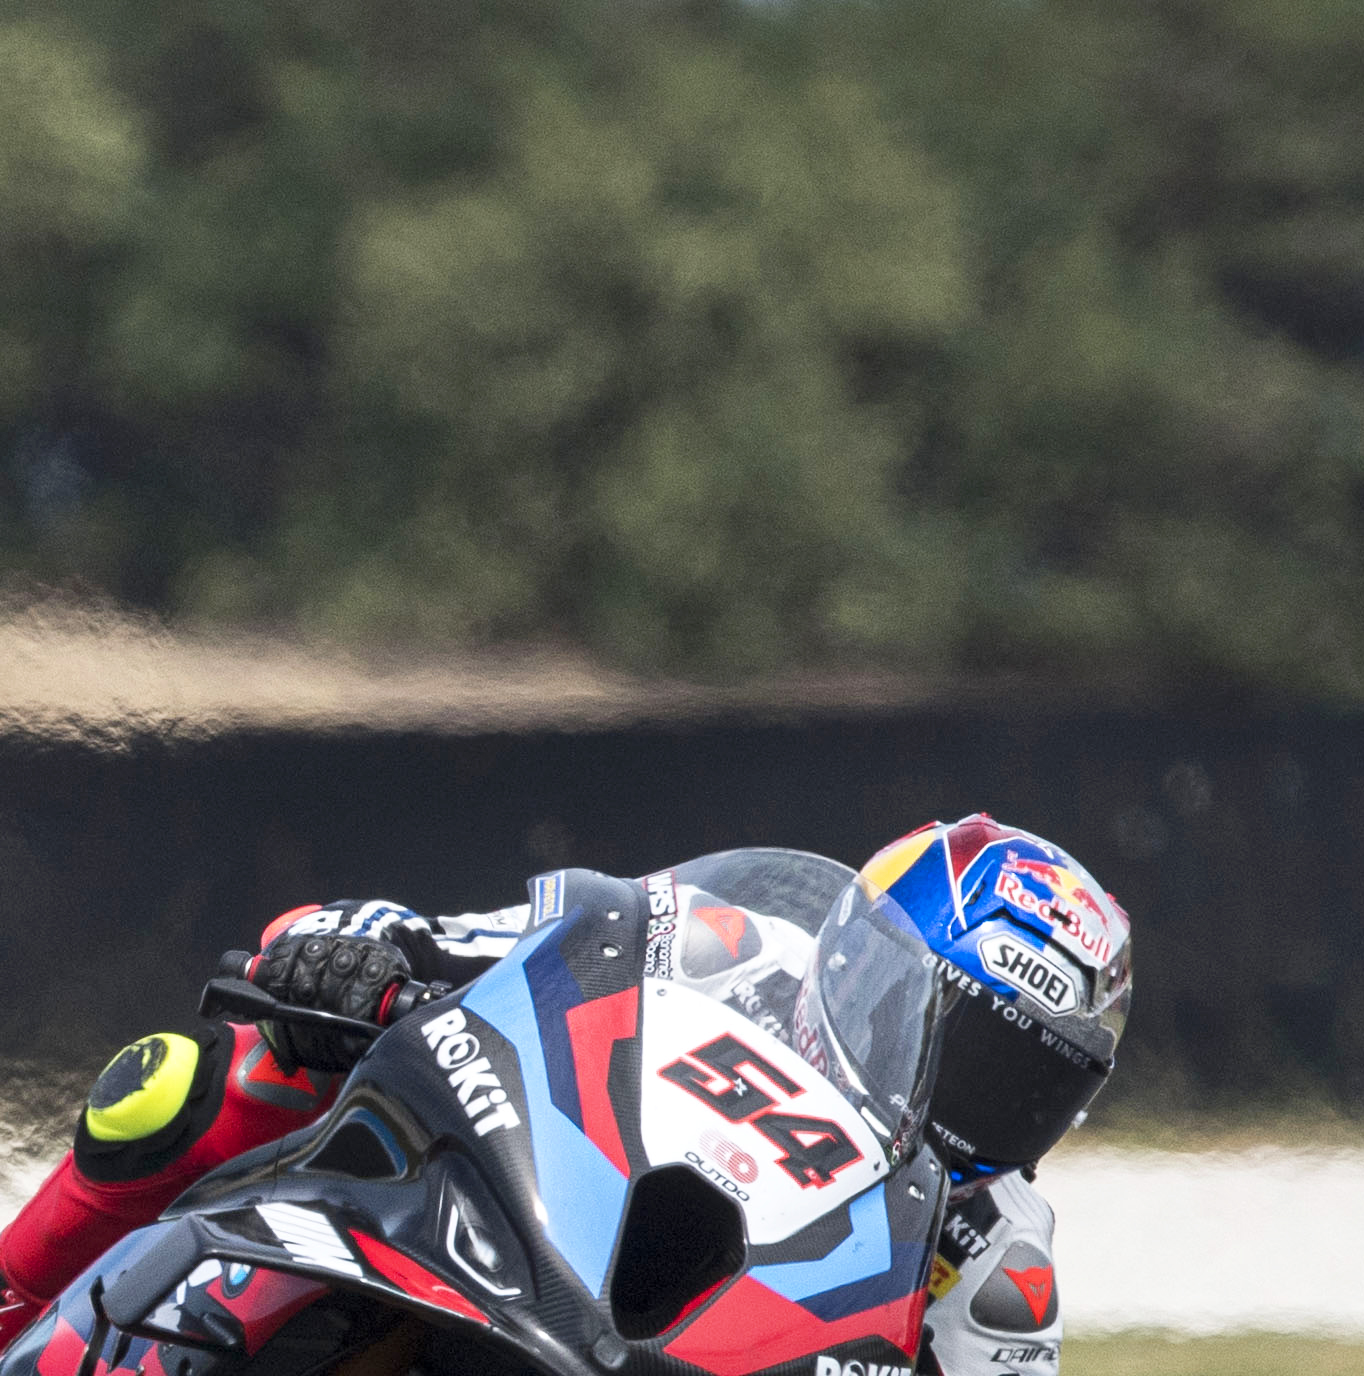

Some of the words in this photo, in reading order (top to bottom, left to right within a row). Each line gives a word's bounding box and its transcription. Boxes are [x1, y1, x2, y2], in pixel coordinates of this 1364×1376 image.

[995, 871, 1062, 922] Red
[1061, 905, 1113, 965] Bull
[922, 952, 983, 998] GIVES
[991, 996, 1034, 1031] YOU
[1039, 1027, 1093, 1070] WINGS
[992, 943, 1070, 1008] SHOEI
[420, 1008, 522, 1138] ROKiT
[656, 1031, 865, 1190] 54
[684, 1151, 751, 1202] OUTDO
[944, 1214, 989, 1258] KiT
